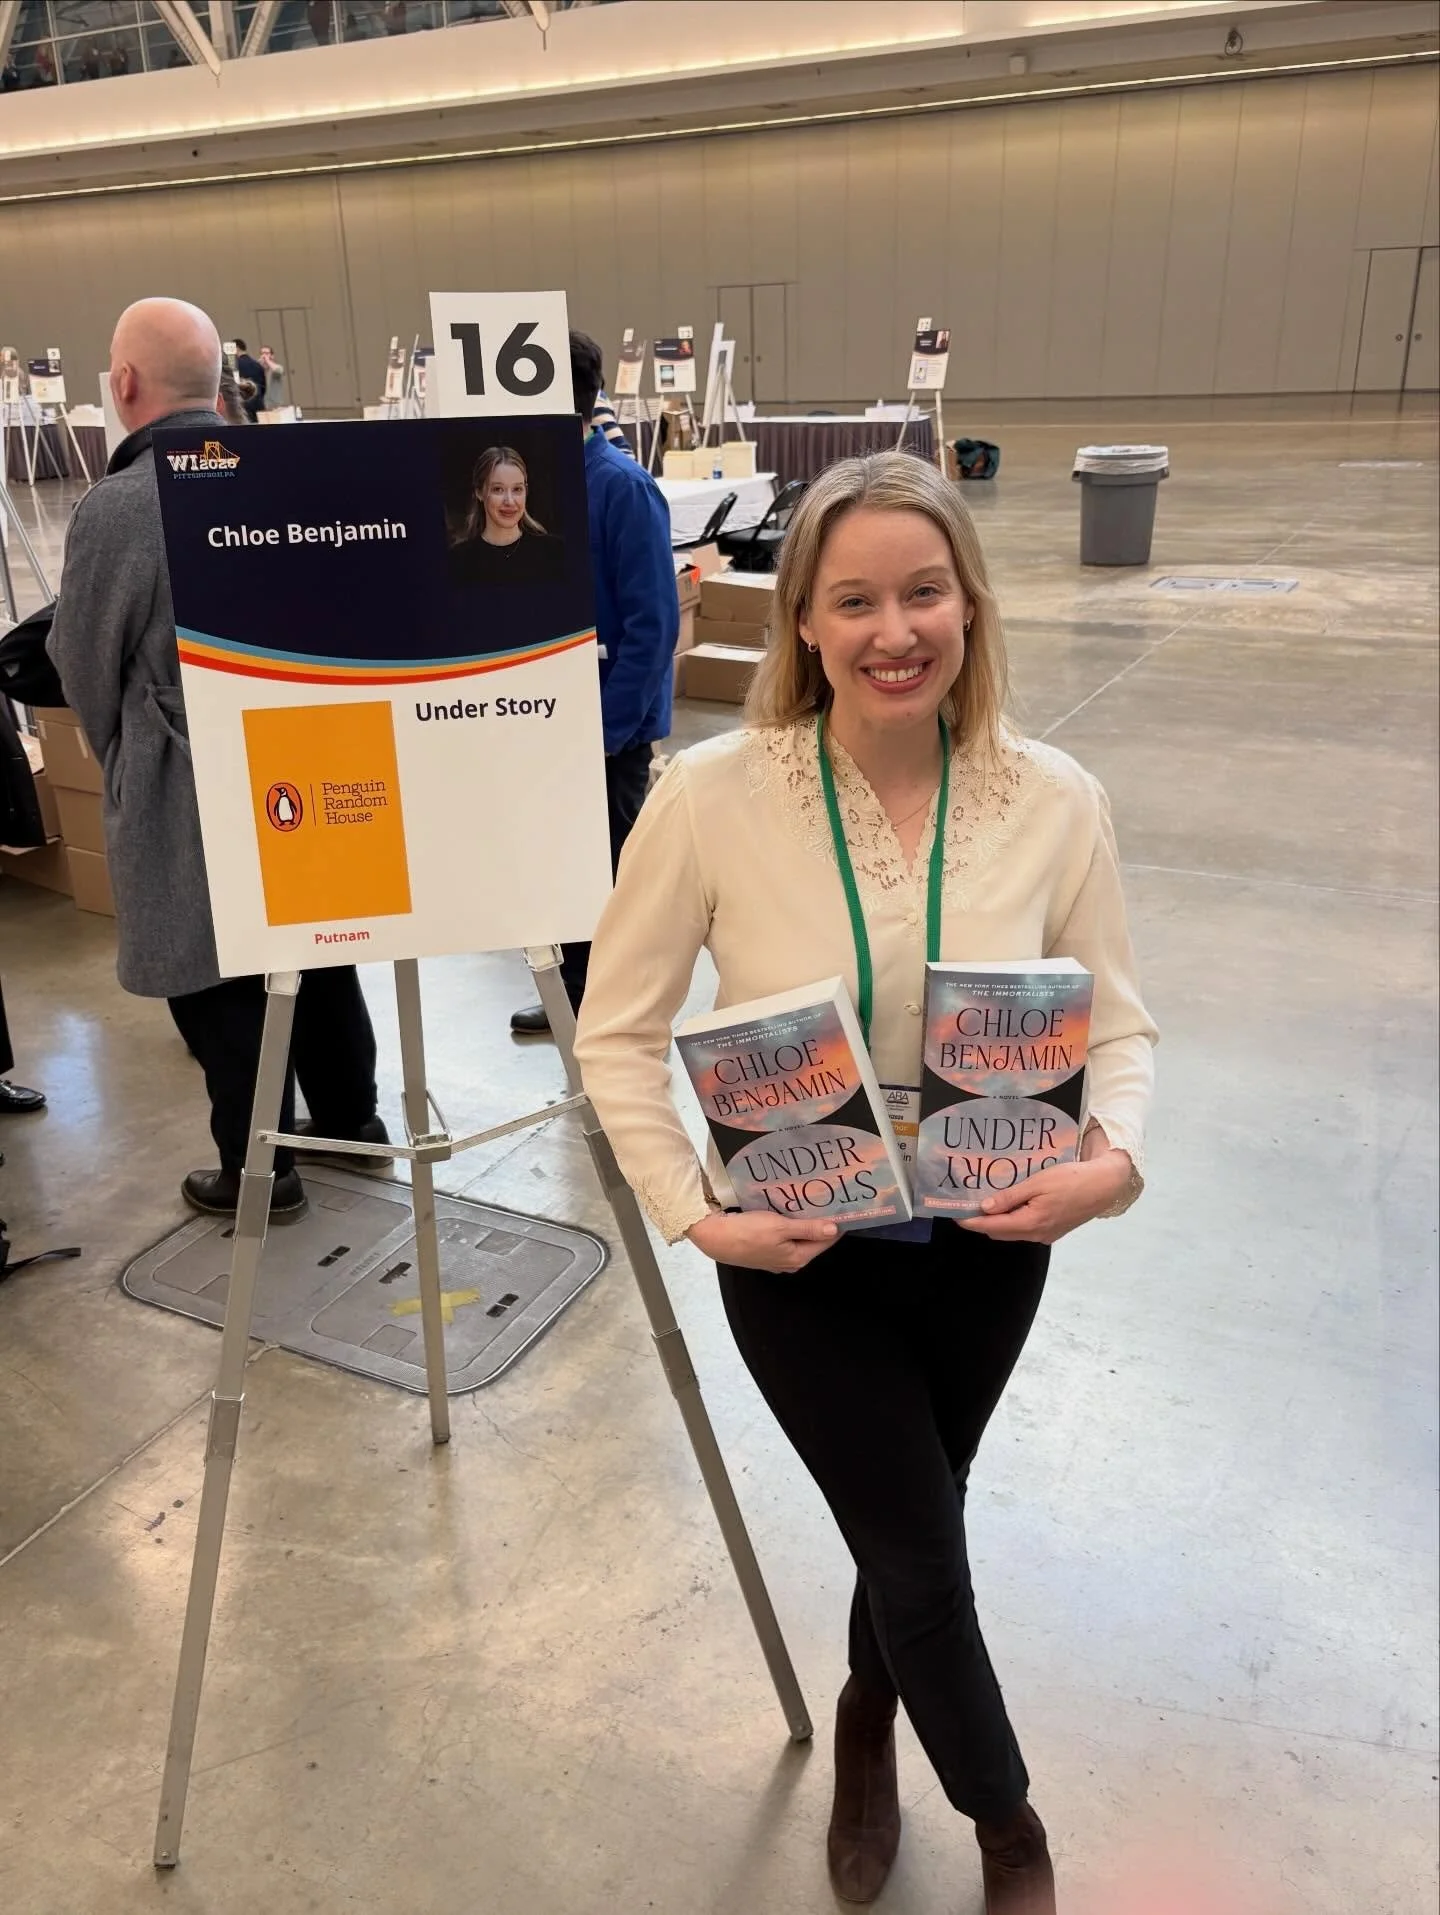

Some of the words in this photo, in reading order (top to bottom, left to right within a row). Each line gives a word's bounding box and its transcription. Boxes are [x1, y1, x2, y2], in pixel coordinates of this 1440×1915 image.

[449, 321, 555, 397] 16
[207, 525, 279, 548] Chloe
[288, 518, 407, 547] Benjamin
[415, 698, 489, 722] Under
[495, 696, 557, 719] Story
[322, 779, 386, 798] Penguin
[323, 794, 388, 810] Random
[325, 809, 373, 826] House
[314, 929, 370, 945] Putnam
[735, 1025, 799, 1045] IMMORTALISTS
[956, 1007, 1064, 1038] CHLOE
[714, 1039, 824, 1085] CHLOE
[940, 1043, 1073, 1071] BENJAMIN
[711, 1067, 847, 1117] BENJAMIN
[944, 1116, 1056, 1150] UNDER
[744, 1136, 865, 1183] UNDER
[762, 1170, 878, 1215] STORY
